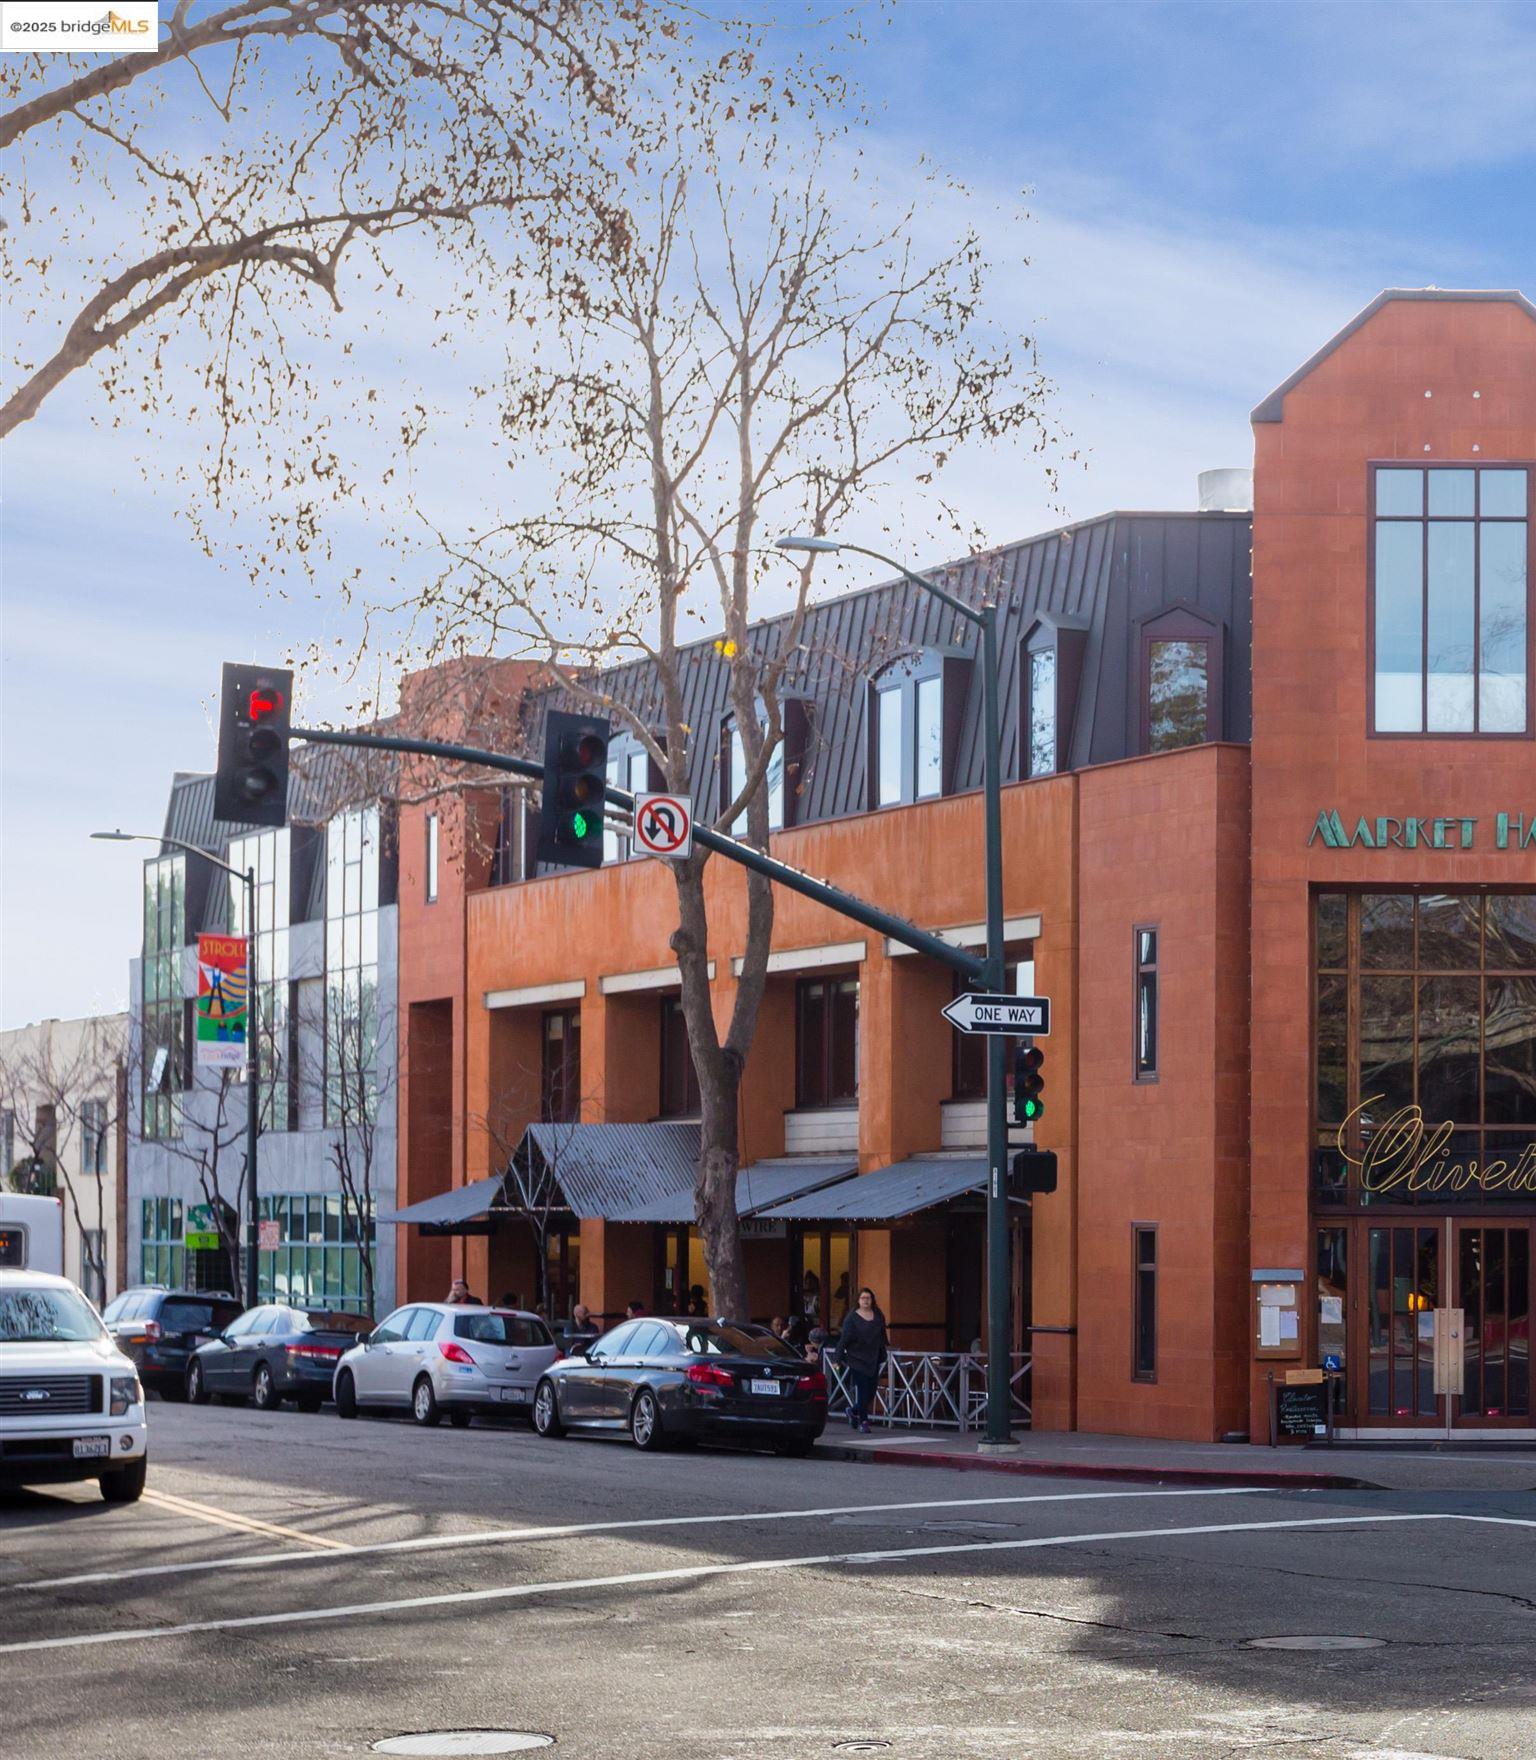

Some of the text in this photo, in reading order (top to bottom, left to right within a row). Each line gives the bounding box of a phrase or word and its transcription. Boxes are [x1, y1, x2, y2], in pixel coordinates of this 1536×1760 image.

[1308, 808, 1478, 849] MARKET
[975, 1006, 1036, 1022] ONE WAY
[741, 1220, 778, 1233] WIRE
